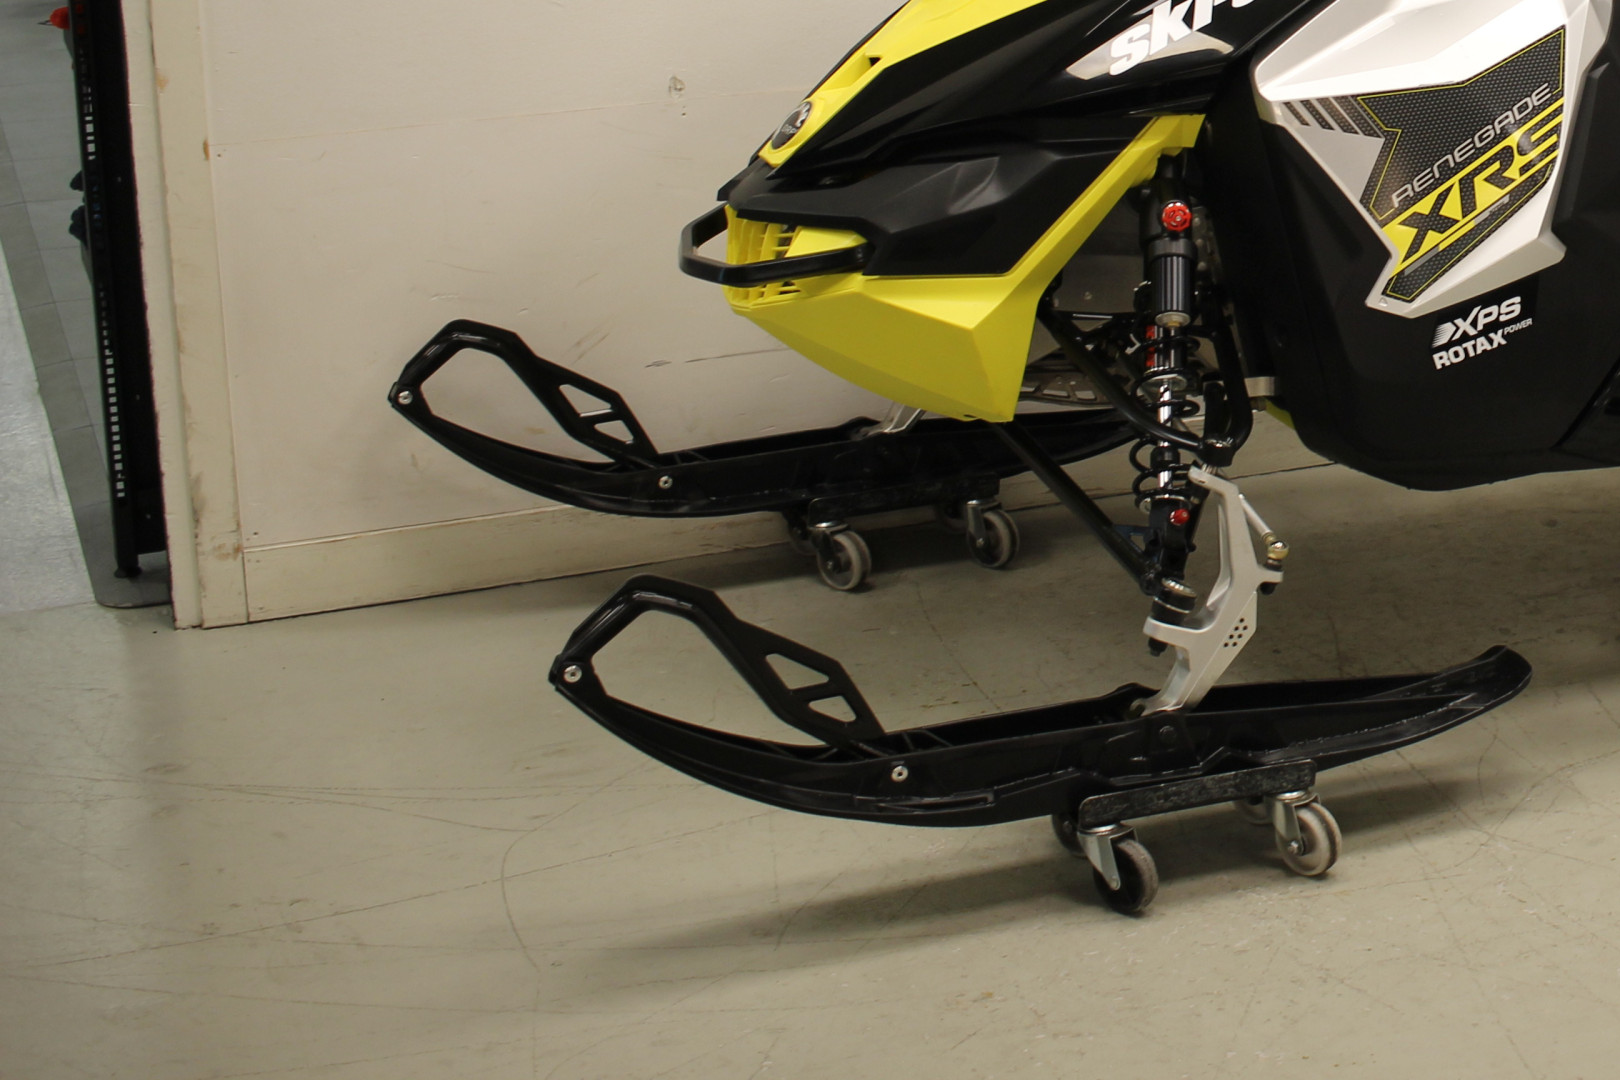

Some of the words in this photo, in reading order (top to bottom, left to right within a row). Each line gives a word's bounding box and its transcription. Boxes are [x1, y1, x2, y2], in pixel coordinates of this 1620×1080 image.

[1391, 82, 1551, 209] RENEGADE
[1396, 112, 1564, 266] XRS
[1432, 328, 1508, 370] ROTAX
[1503, 318, 1533, 336] POWER
[1451, 296, 1522, 341] XPS
